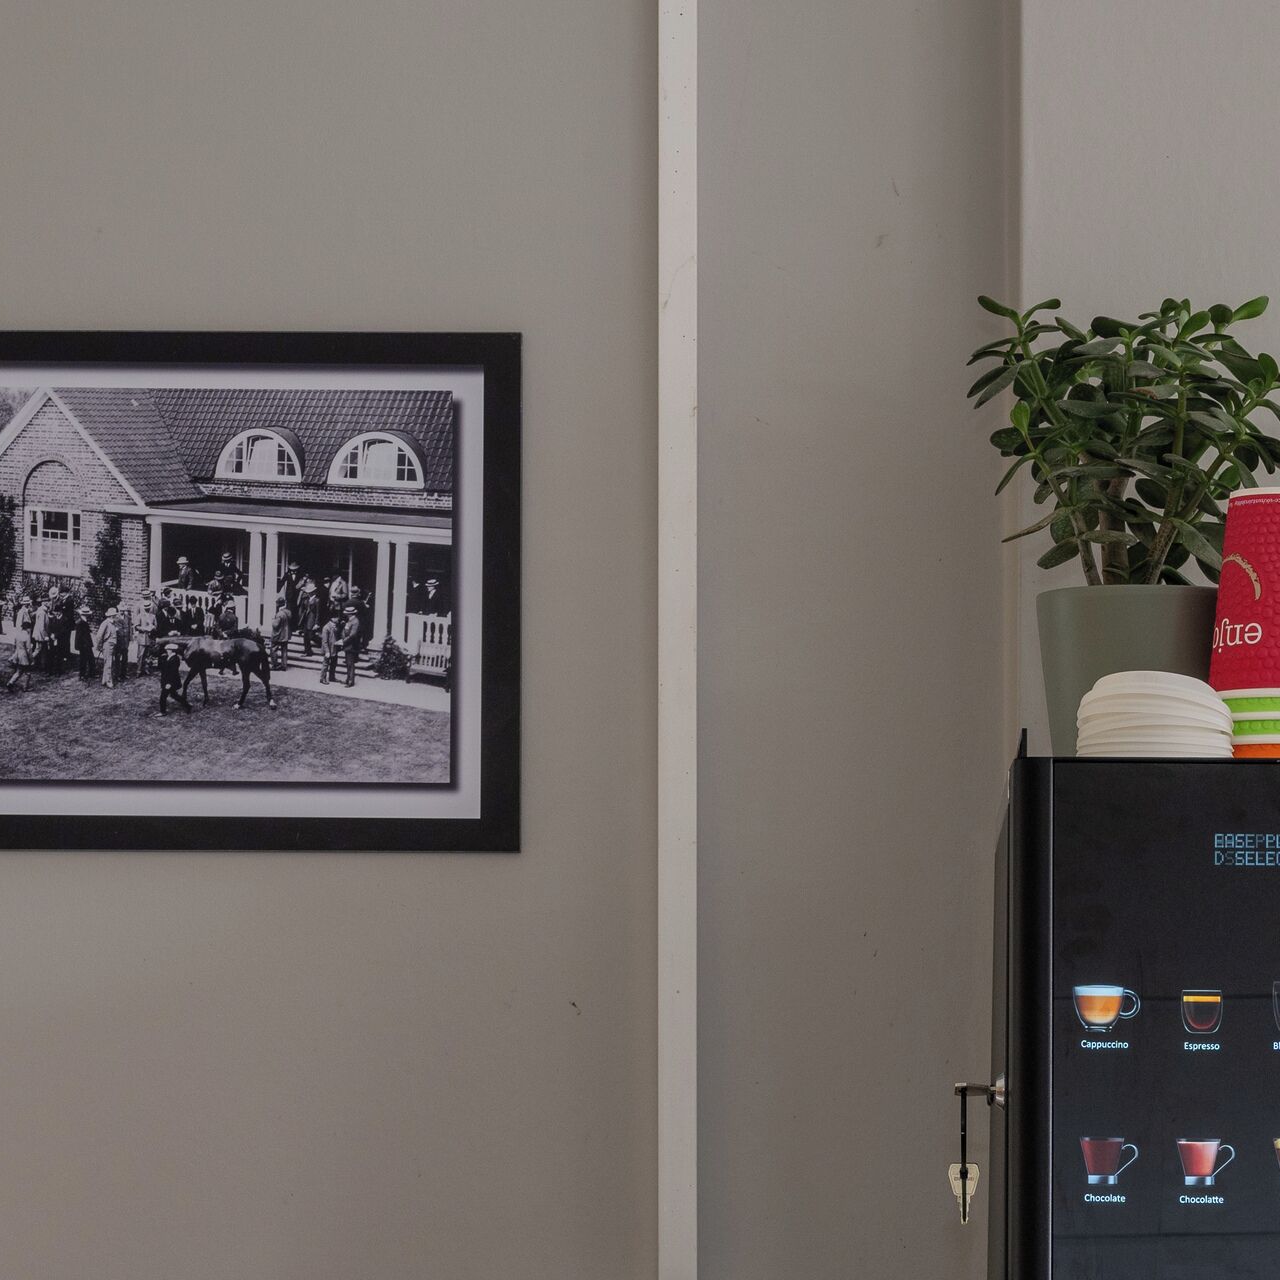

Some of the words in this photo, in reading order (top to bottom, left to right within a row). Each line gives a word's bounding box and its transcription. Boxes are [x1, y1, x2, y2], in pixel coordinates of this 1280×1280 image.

[1212, 618, 1263, 653] enjo
[1081, 1040, 1129, 1050] Cappuccino
[1184, 1042, 1220, 1051] Espresso
[1084, 1193, 1126, 1203] Chocolate
[1179, 1195, 1224, 1204] Chocolatte
